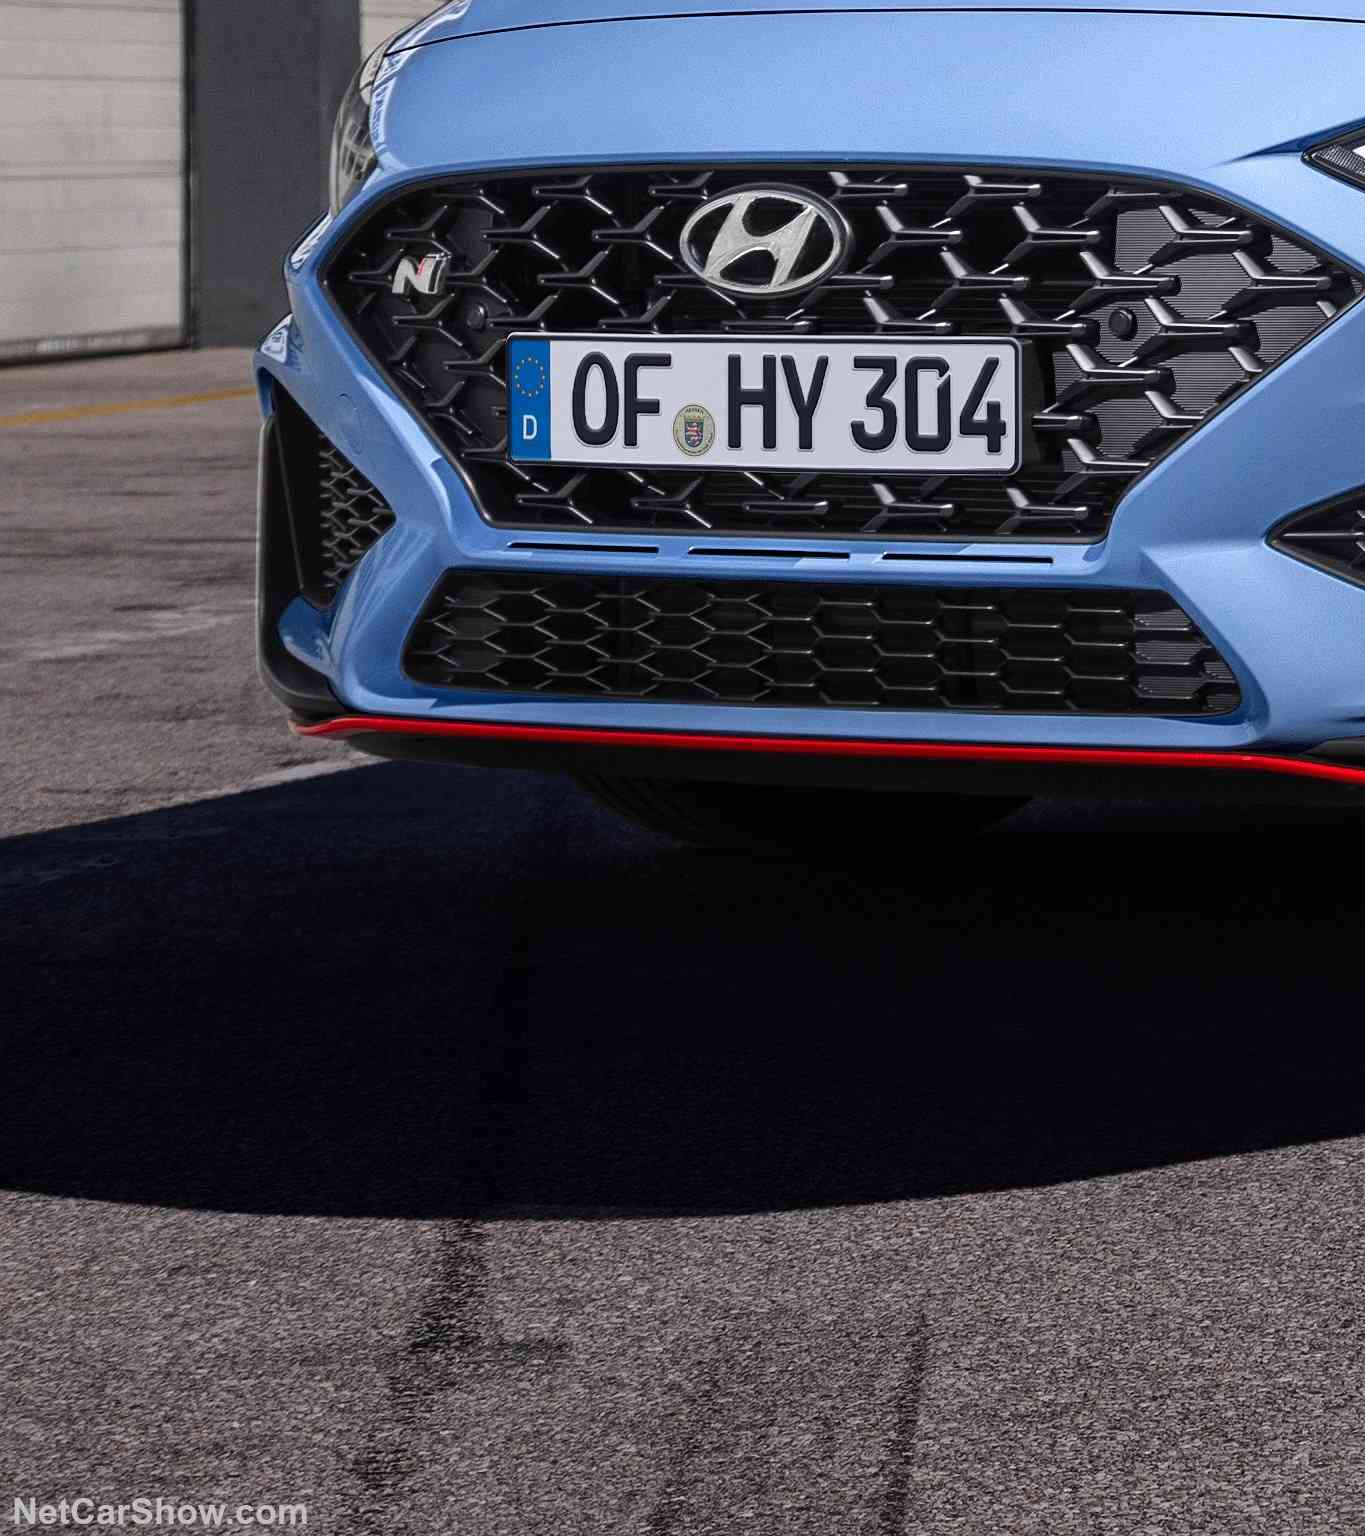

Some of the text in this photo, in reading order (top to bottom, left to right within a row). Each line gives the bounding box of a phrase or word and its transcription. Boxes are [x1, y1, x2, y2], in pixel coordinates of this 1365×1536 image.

[523, 414, 538, 440] D
[572, 351, 1007, 453] OF HY 304
